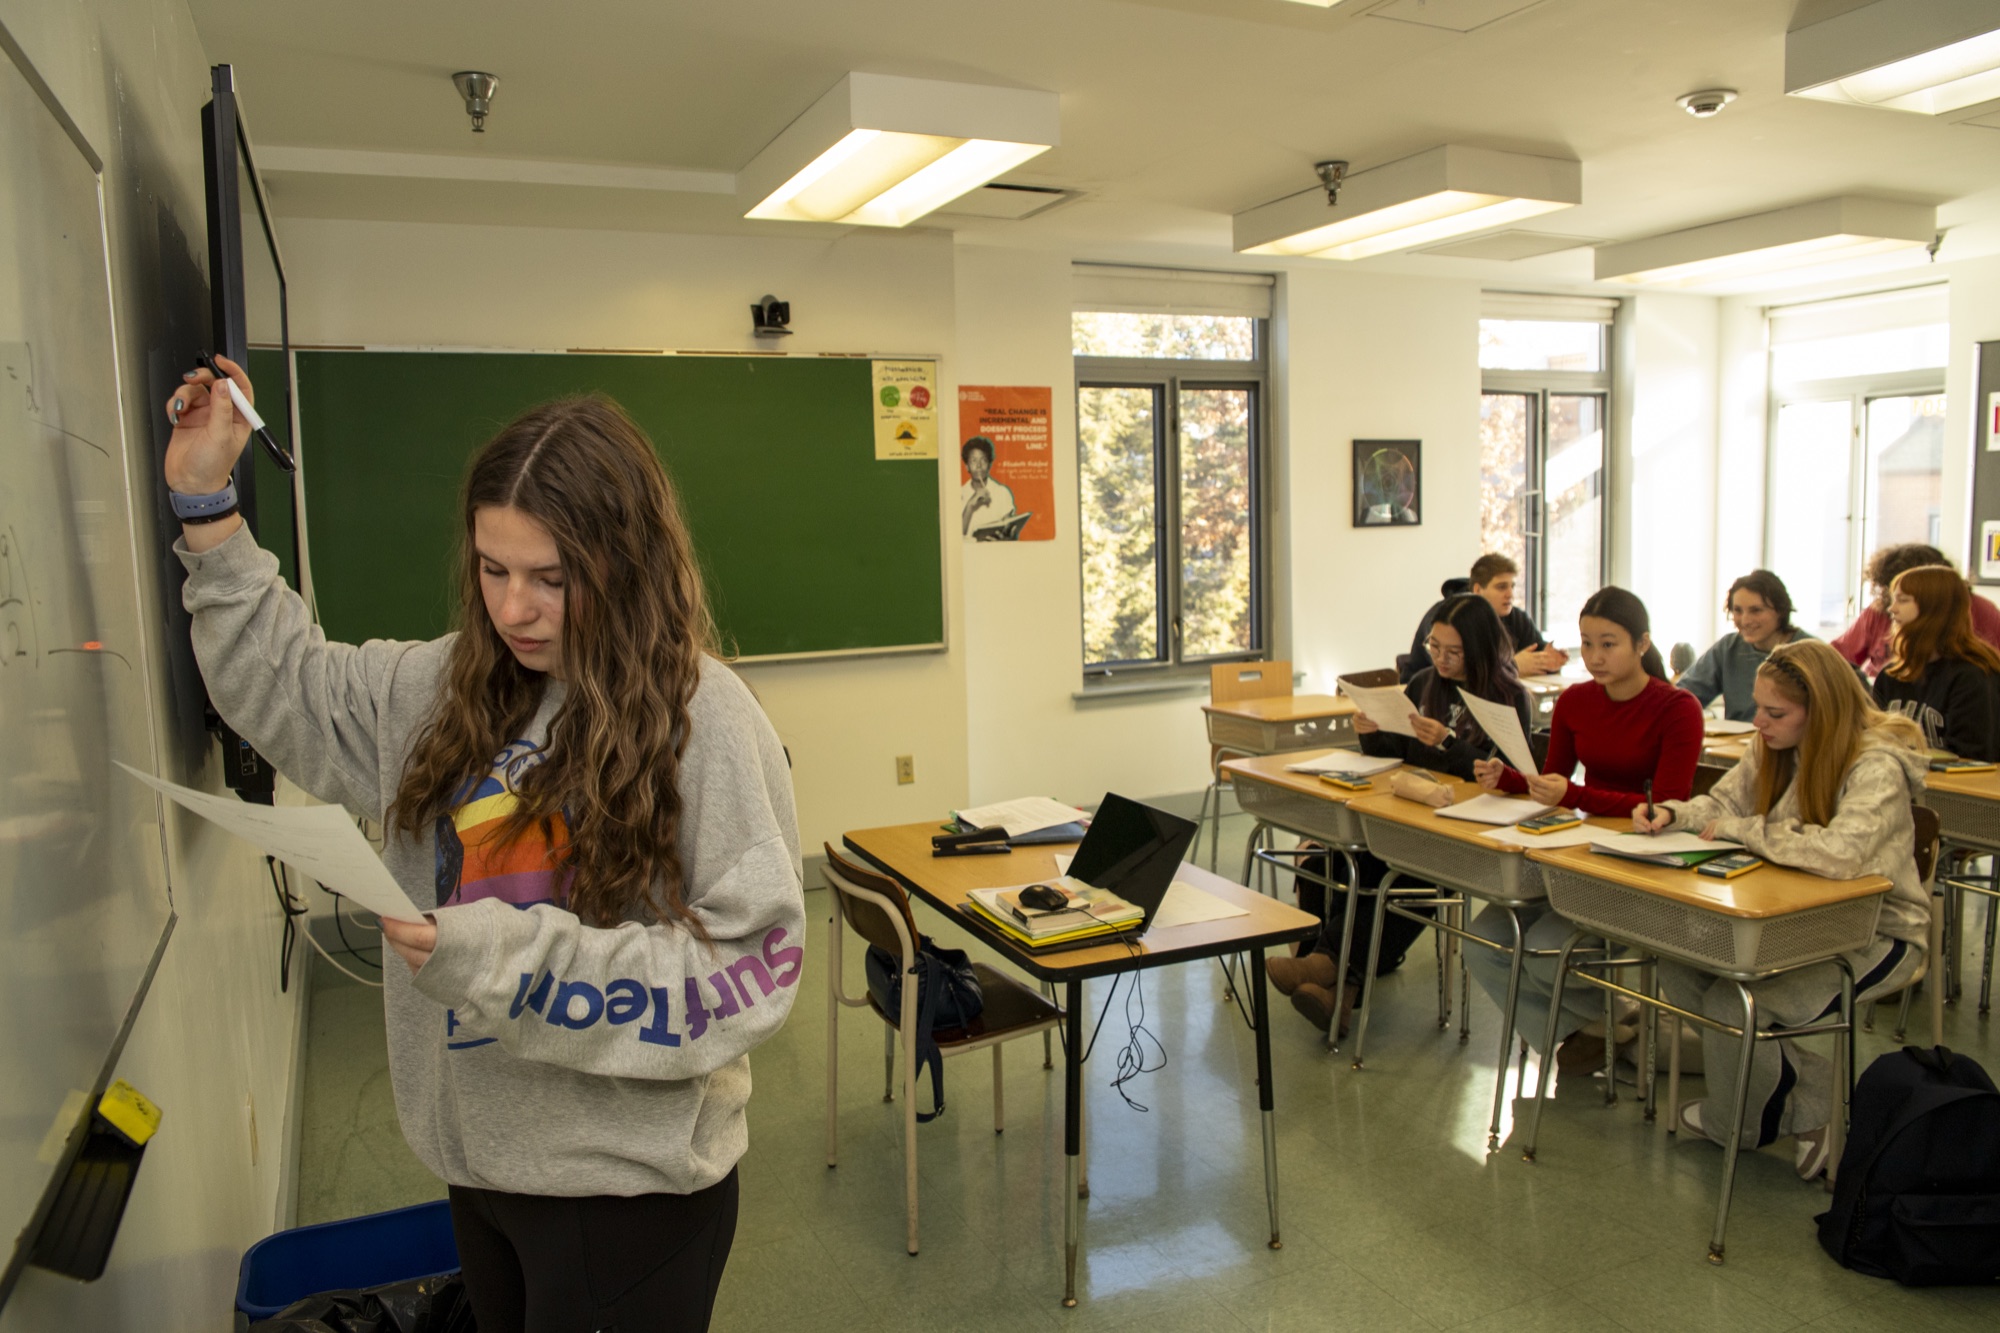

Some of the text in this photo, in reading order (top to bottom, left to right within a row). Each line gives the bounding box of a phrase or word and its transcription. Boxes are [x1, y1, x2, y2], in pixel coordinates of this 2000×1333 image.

[980, 425, 1047, 433] DOESN'T PROCEED
[995, 434, 1047, 442] IN A STRAIGHT
